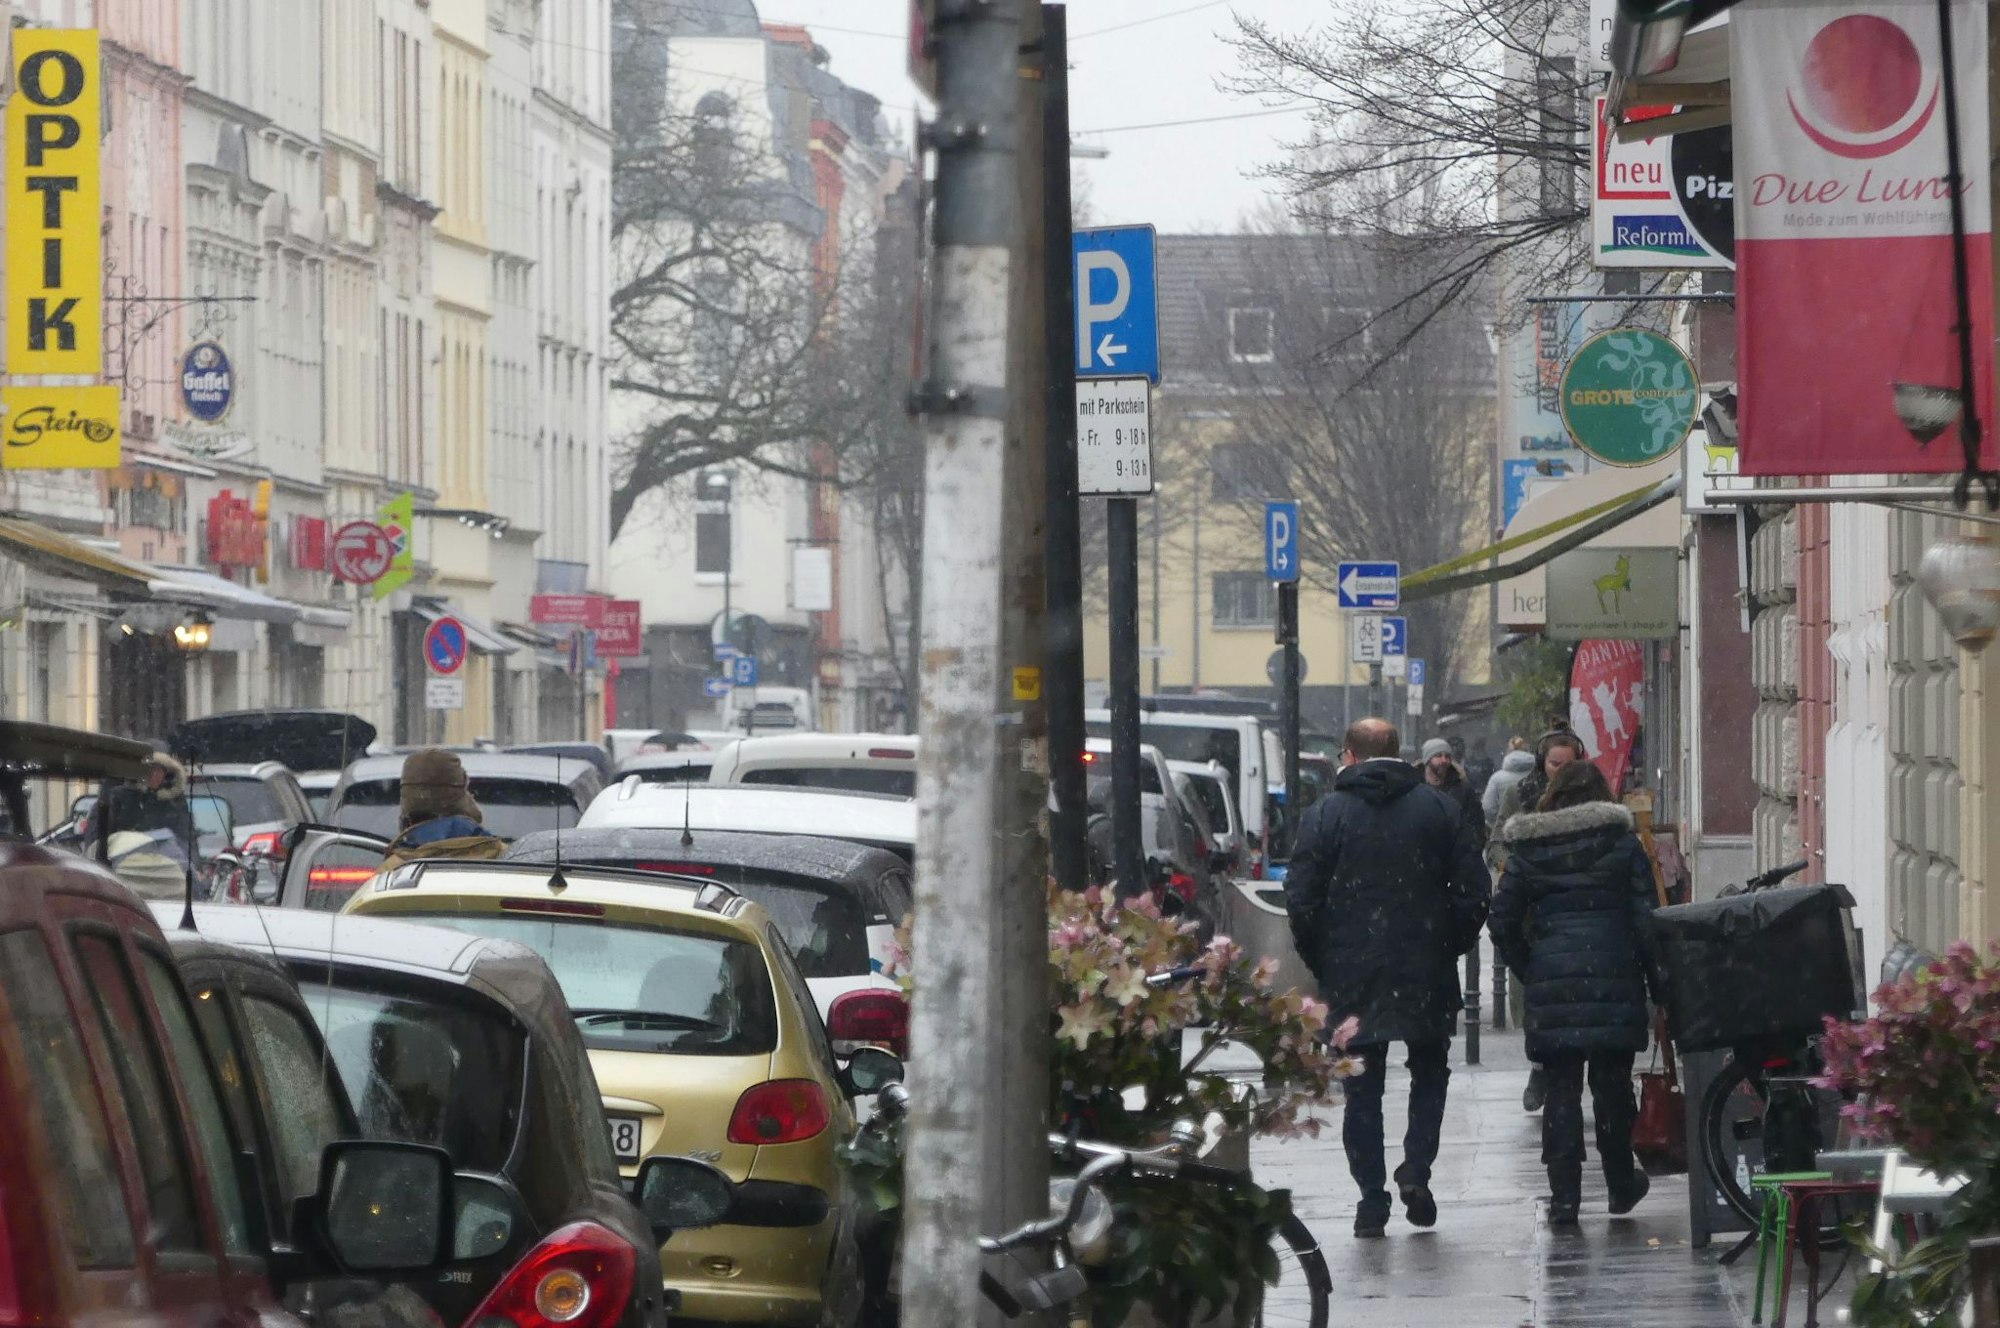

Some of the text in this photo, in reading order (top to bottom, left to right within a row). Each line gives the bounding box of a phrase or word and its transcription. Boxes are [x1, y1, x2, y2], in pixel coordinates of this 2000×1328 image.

[1614, 161, 1662, 184] neu
[18, 49, 84, 351] OPTIK
[1753, 173, 1849, 207] Due
[1783, 213, 1823, 227] Mode
[1828, 213, 1858, 226] zum
[1077, 250, 1131, 369] P
[183, 371, 230, 391] Gaffel
[1080, 397, 1145, 415] mit Parkschein
[1571, 390, 1634, 405] GROTE
[1272, 512, 1290, 571] P
